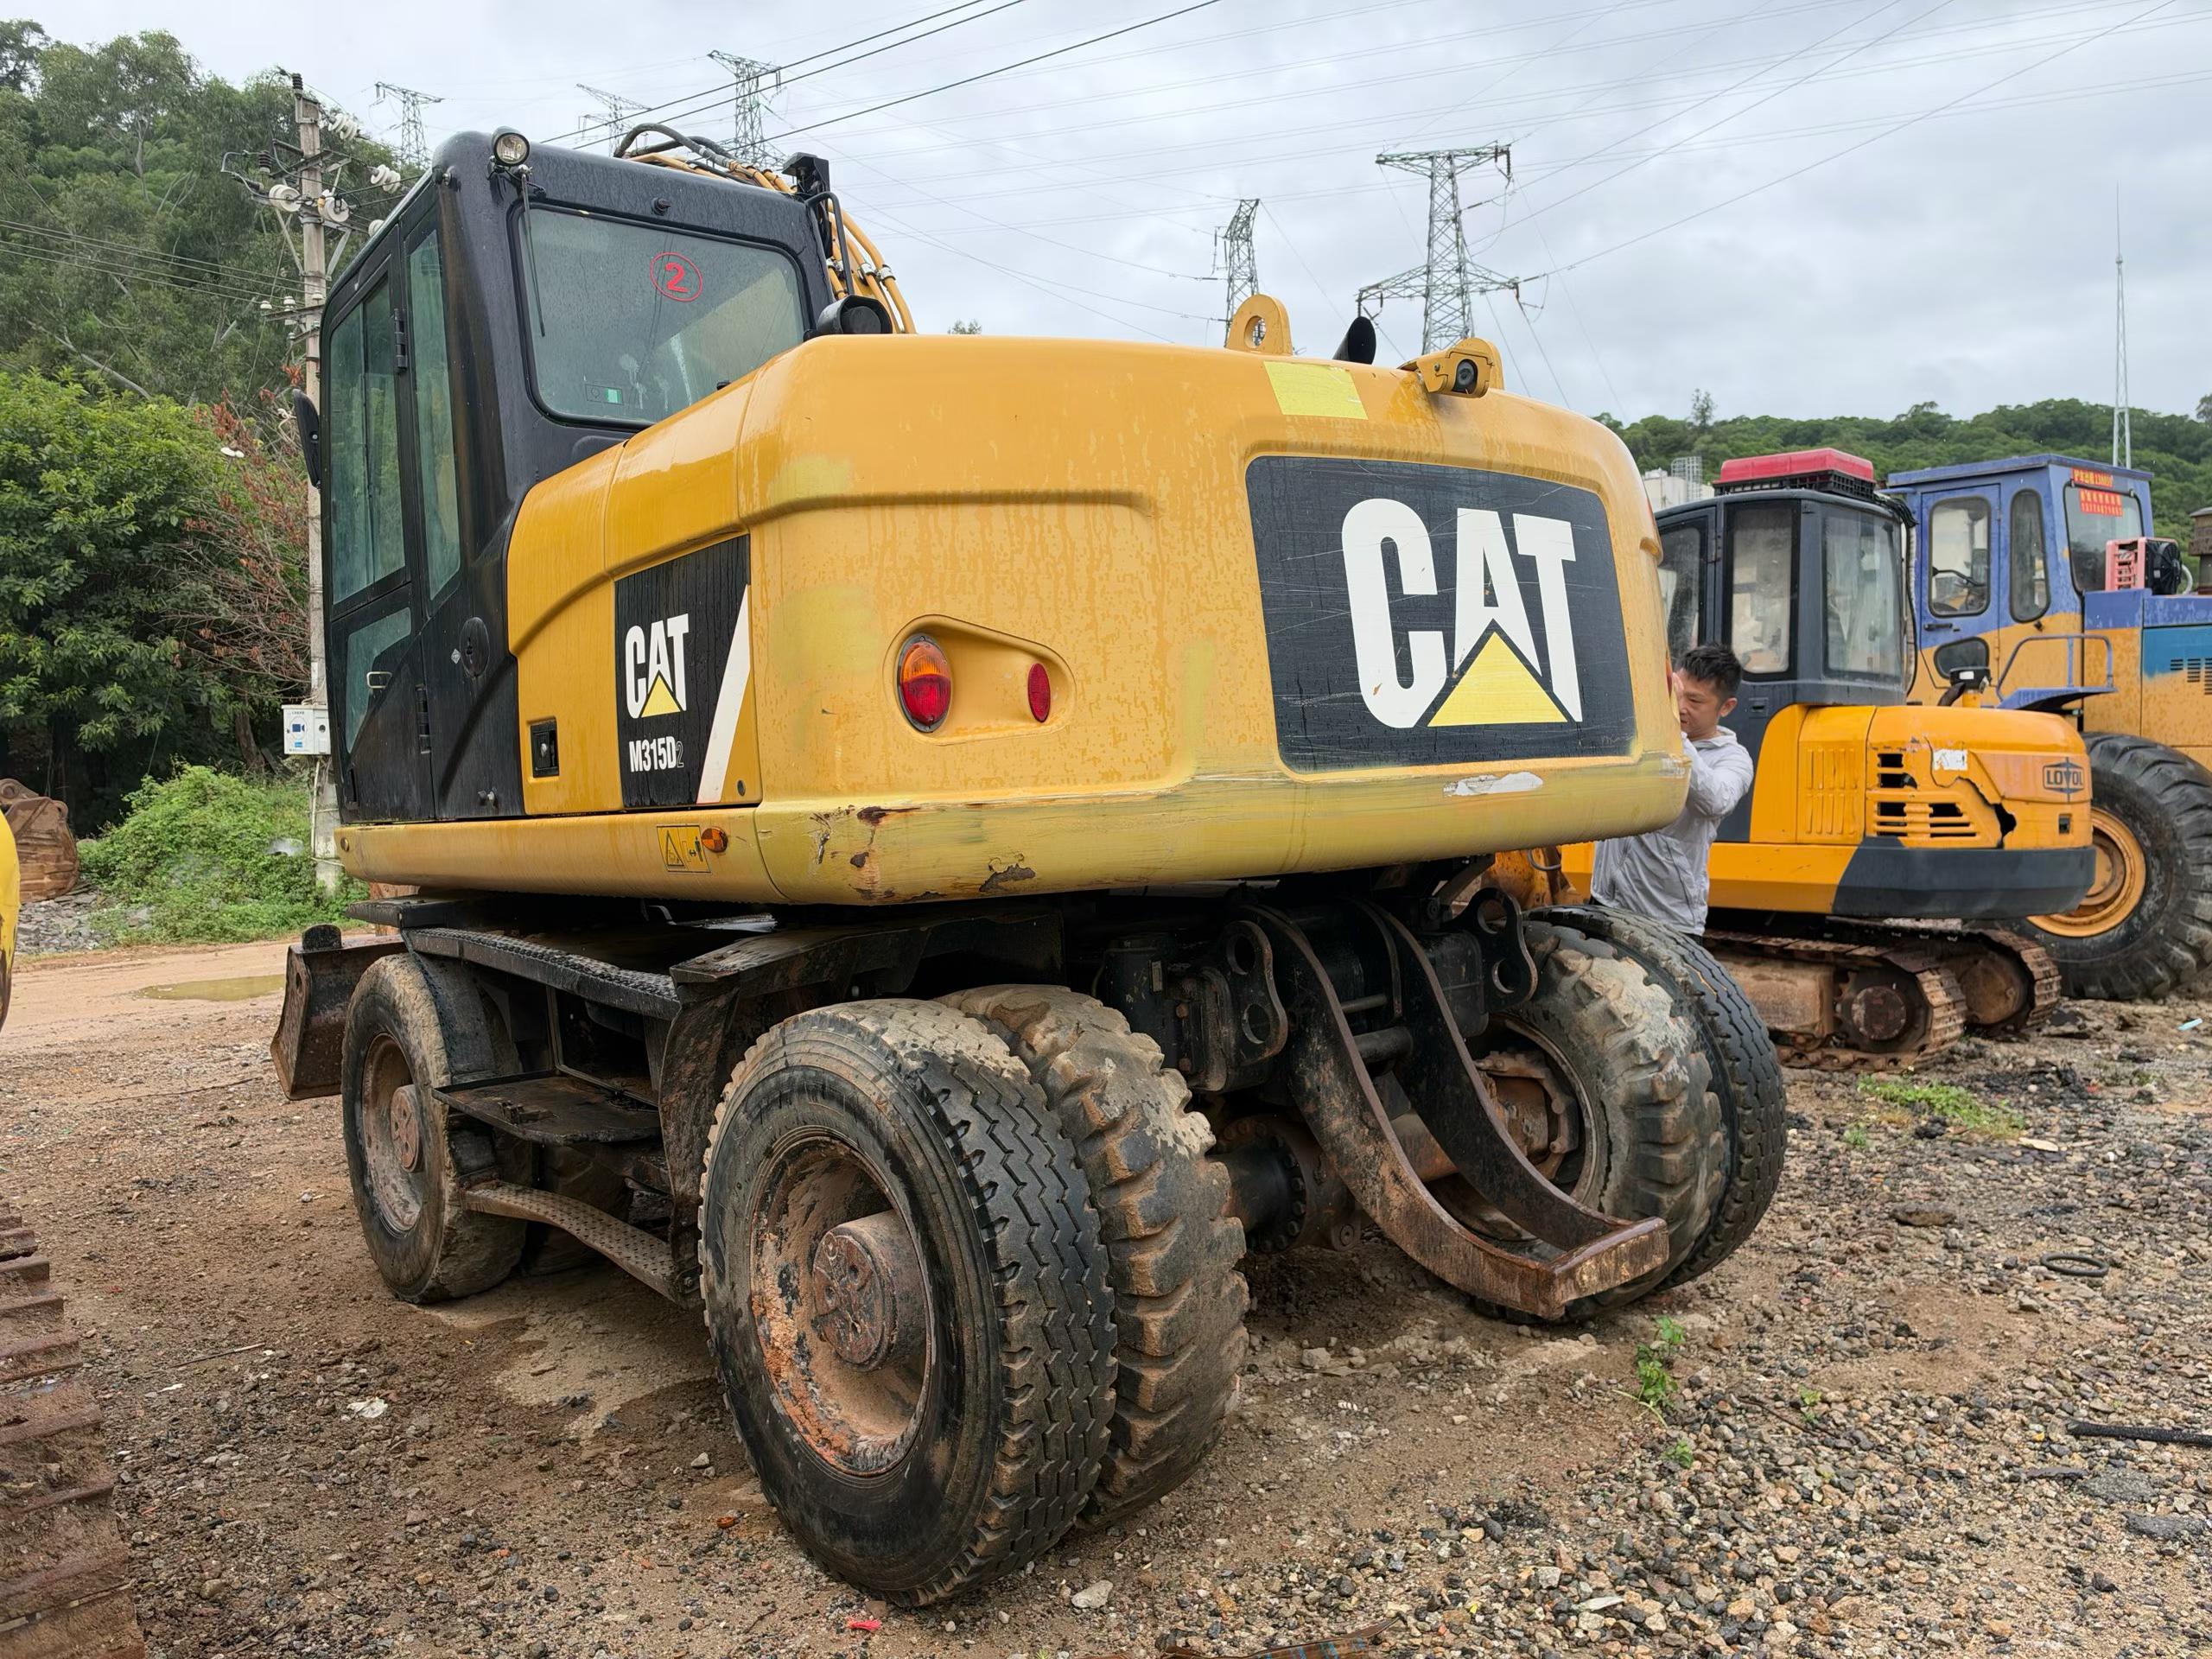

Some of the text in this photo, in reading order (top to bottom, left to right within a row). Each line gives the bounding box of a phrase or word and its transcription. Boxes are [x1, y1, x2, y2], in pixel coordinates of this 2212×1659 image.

[665, 262, 690, 293] 2
[1341, 498, 1583, 728] CAT
[625, 613, 690, 718] CAT
[628, 735, 684, 772] M315D2
[2046, 769, 2083, 787] LOVOL
